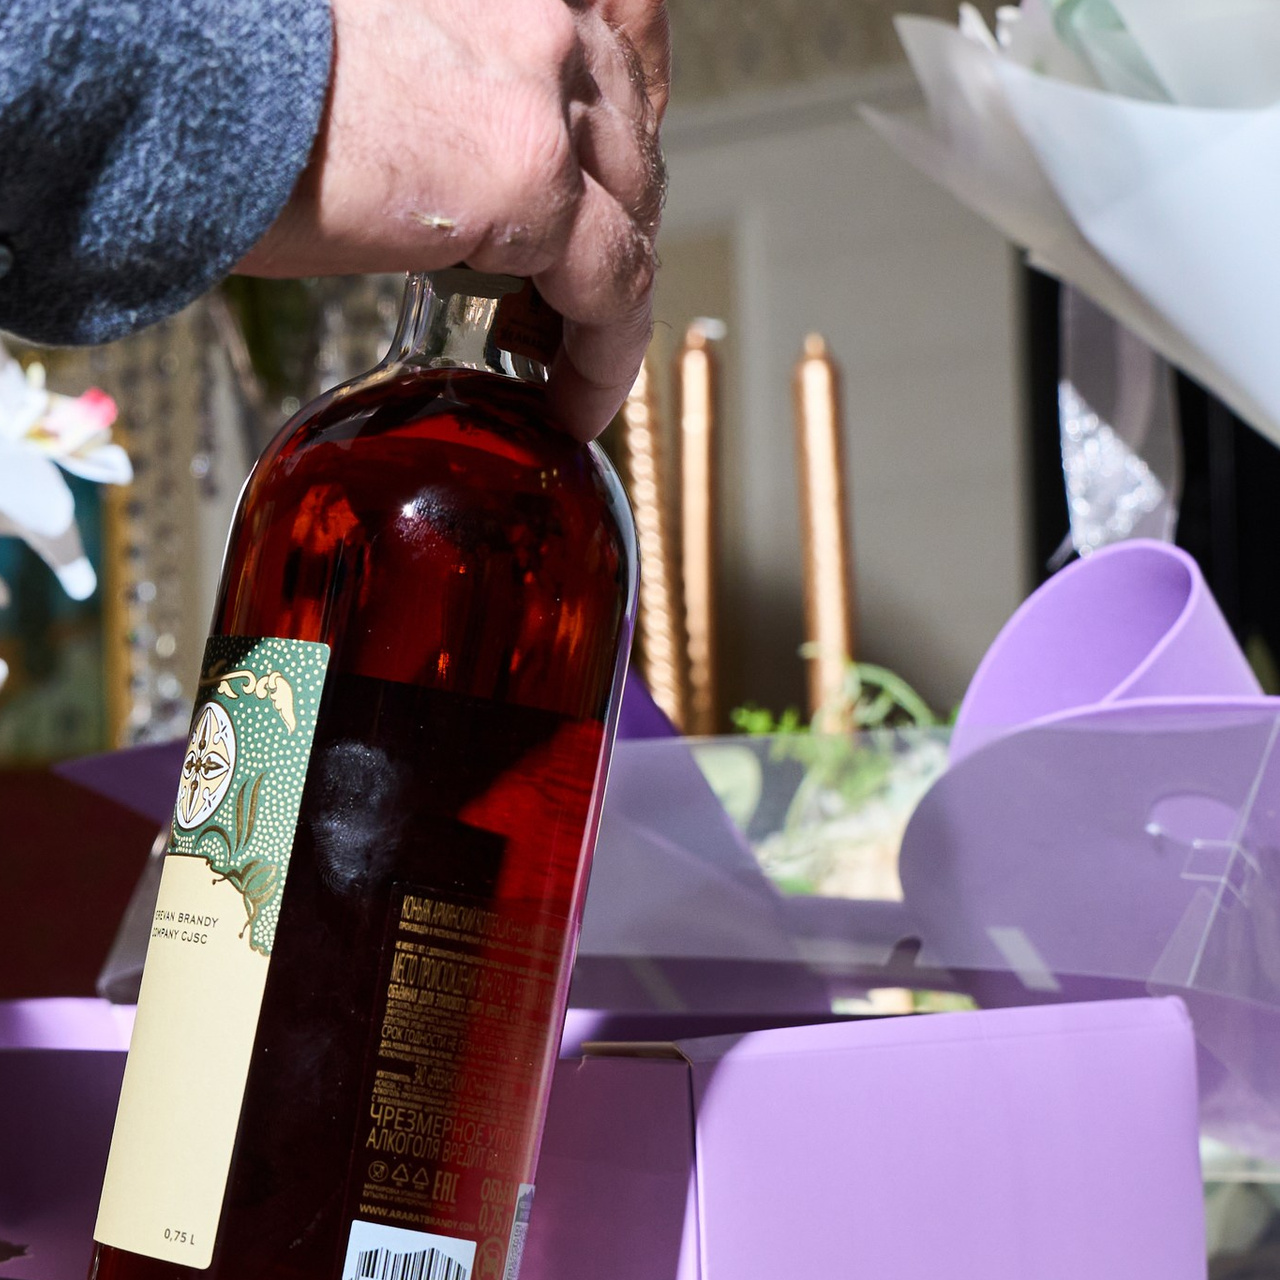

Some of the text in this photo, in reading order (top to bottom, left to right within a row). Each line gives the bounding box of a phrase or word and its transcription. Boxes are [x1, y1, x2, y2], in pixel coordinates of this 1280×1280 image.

[178, 912, 219, 928] BRANDY
[400, 895, 436, 922] КОНЬЯК
[181, 930, 208, 945] CJSC
[390, 951, 418, 985] МЕСТО
[380, 1025, 404, 1041] СРОК
[403, 1029, 447, 1049] ГОДНОСТИ
[446, 1037, 457, 1051] НЕ
[370, 1103, 487, 1145] ЧРЕЗМЕРНОЕ
[366, 1127, 441, 1161] АЛКОГОЛЯ
[442, 1141, 488, 1169] ВРЕДИТ
[359, 1203, 476, 1233] WWW.ARARATBRANDY.COM
[164, 1228, 195, 1245] 0,75 L
